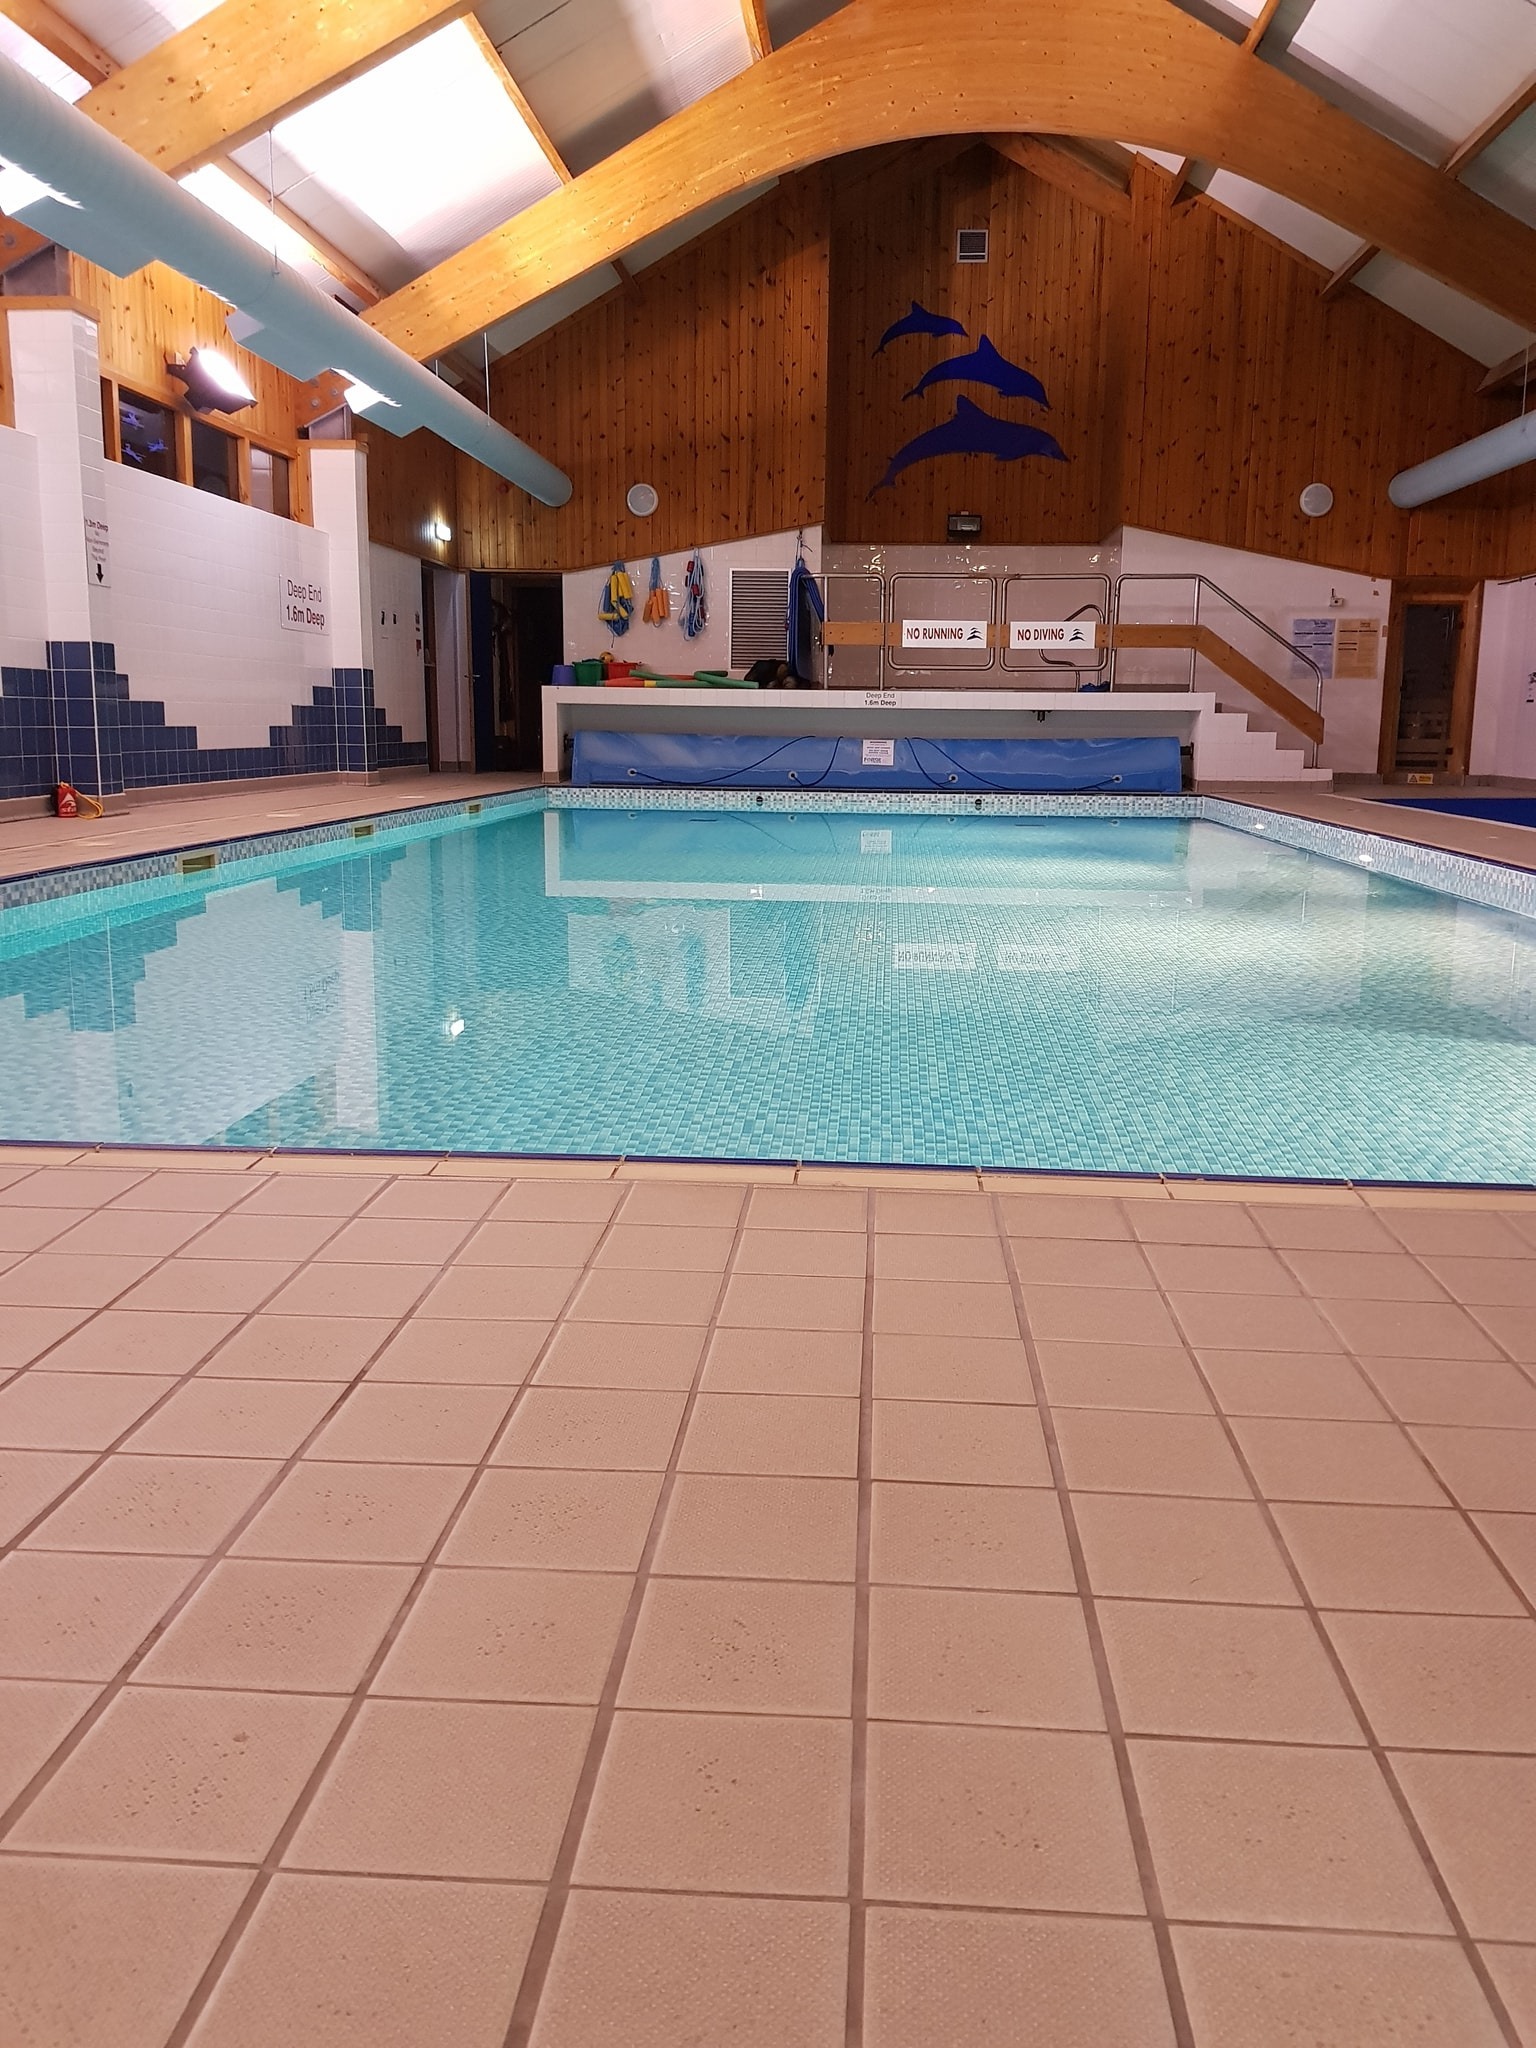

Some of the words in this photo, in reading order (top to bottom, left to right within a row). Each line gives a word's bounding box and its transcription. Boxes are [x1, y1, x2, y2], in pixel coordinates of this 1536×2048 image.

[287, 579, 306, 603] Deep
[308, 584, 322, 602] End
[286, 604, 305, 623] 1.6m
[306, 607, 325, 630] Deep
[906, 627, 920, 640] NO
[922, 627, 964, 640] RUNNING
[1017, 629, 1031, 641] NO
[1033, 628, 1065, 641] DIVING
